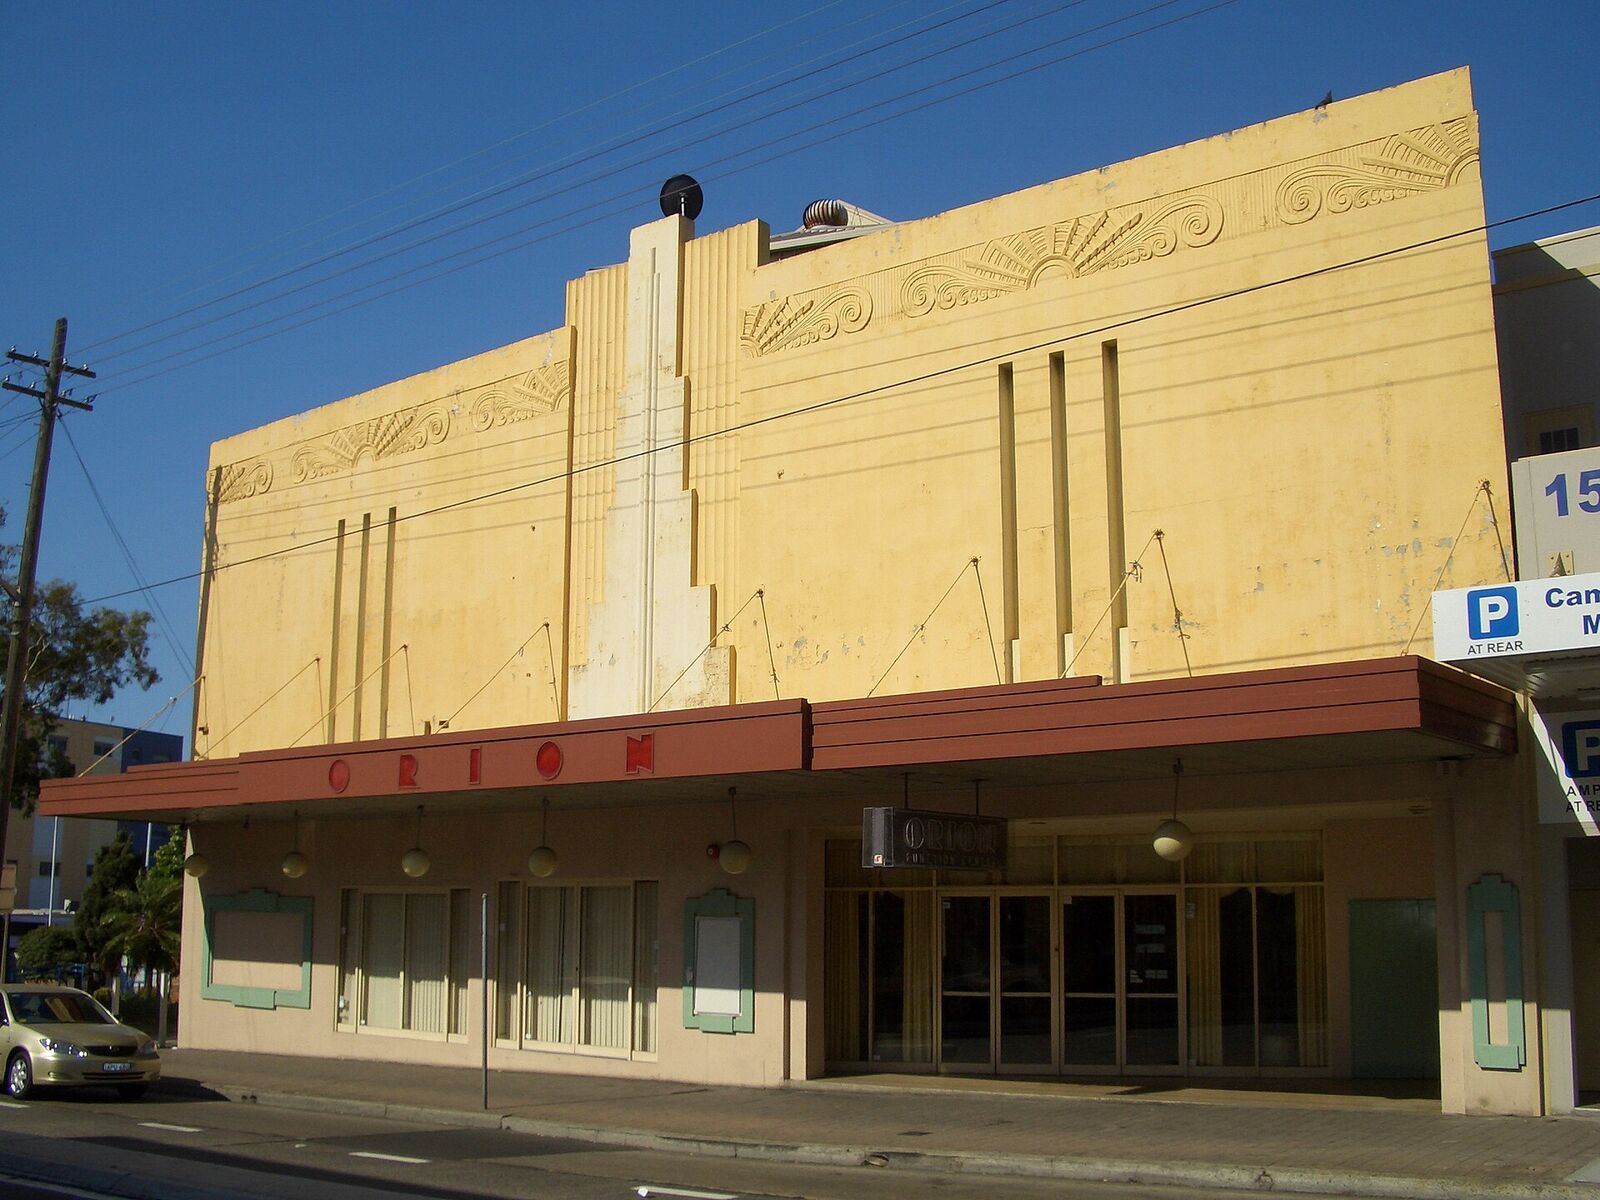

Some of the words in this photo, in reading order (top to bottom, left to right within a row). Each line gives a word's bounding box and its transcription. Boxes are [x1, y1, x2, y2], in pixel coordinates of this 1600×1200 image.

[1545, 469, 1600, 517] 15
[1479, 595, 1509, 634] P
[1467, 643, 1483, 655] AT
[1487, 640, 1524, 653] REAR
[328, 732, 655, 794] ORION
[1565, 800, 1582, 813] AT
[905, 817, 996, 852] ORION
